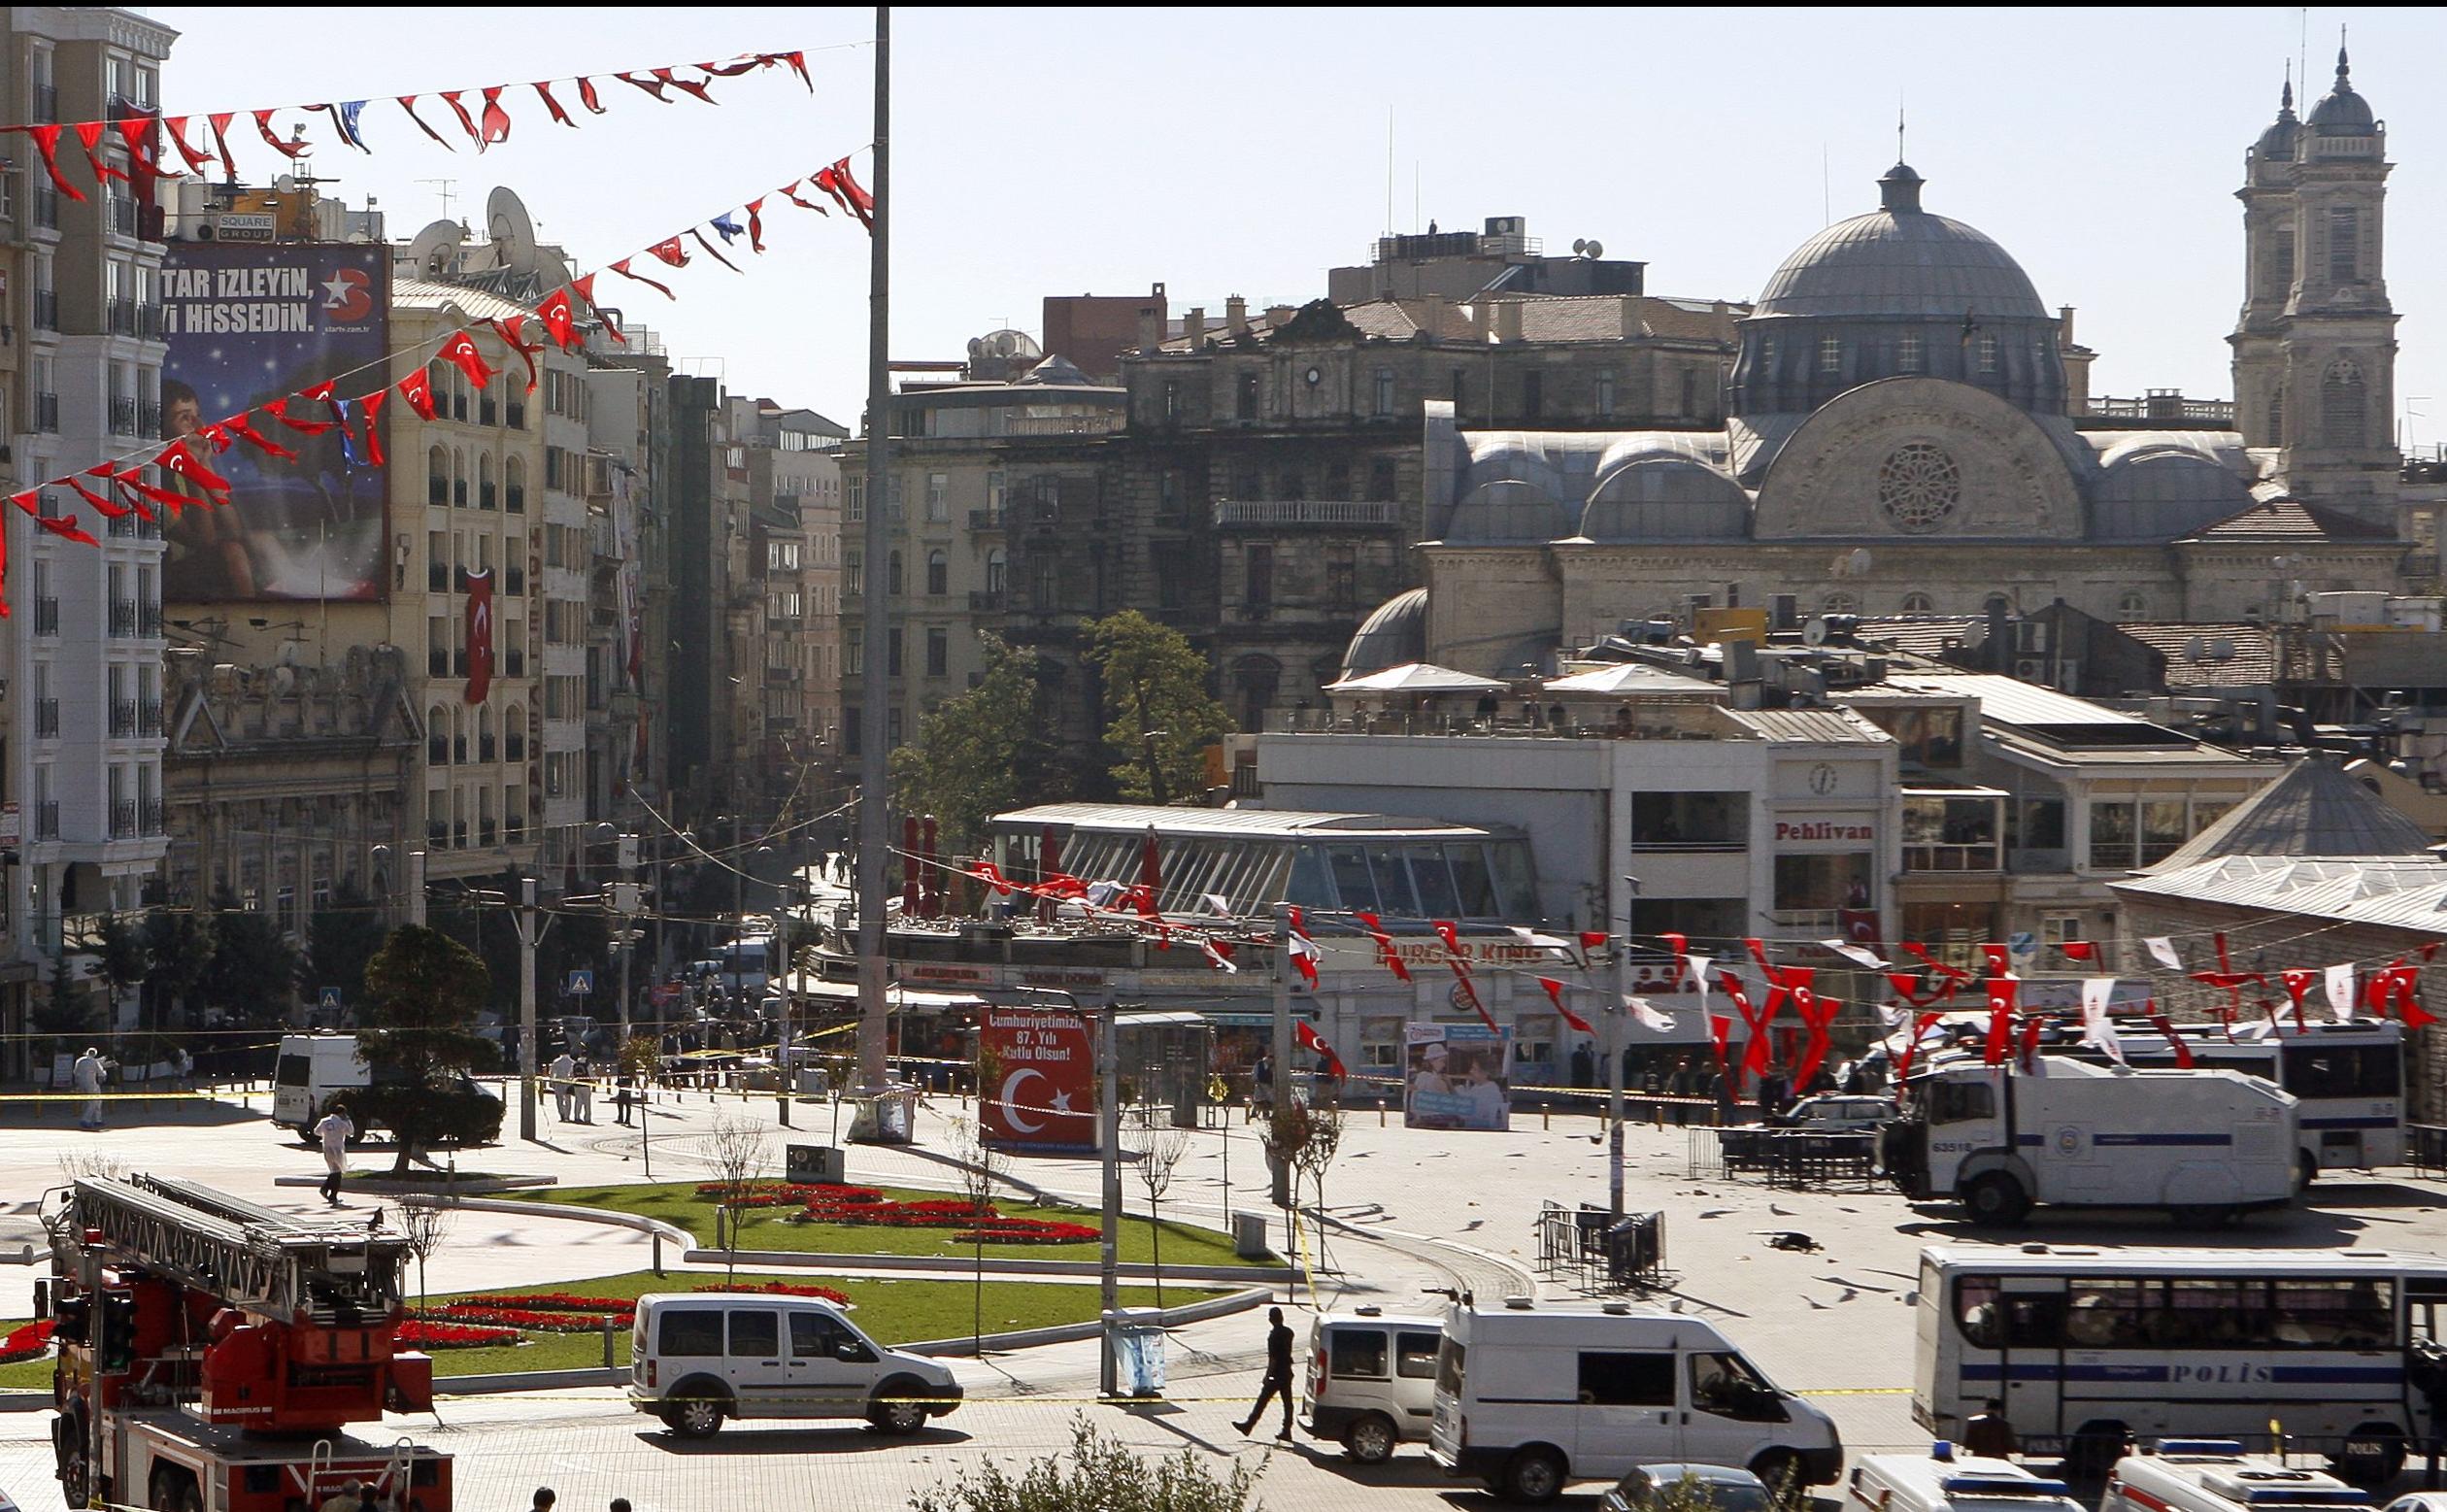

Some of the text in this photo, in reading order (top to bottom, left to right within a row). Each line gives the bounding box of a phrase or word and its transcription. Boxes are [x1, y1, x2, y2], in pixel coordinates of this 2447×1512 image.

[220, 217, 272, 227] SQUARE
[219, 230, 272, 239] GROUP
[528, 527, 540, 659] HOTEL
[1775, 822, 1873, 841] Pehlivan
[1016, 1030, 1057, 1045] 87. Yılı
[1001, 1045, 1071, 1061] Kutlu Olsun!
[2173, 1361, 2271, 1383] POLİS
